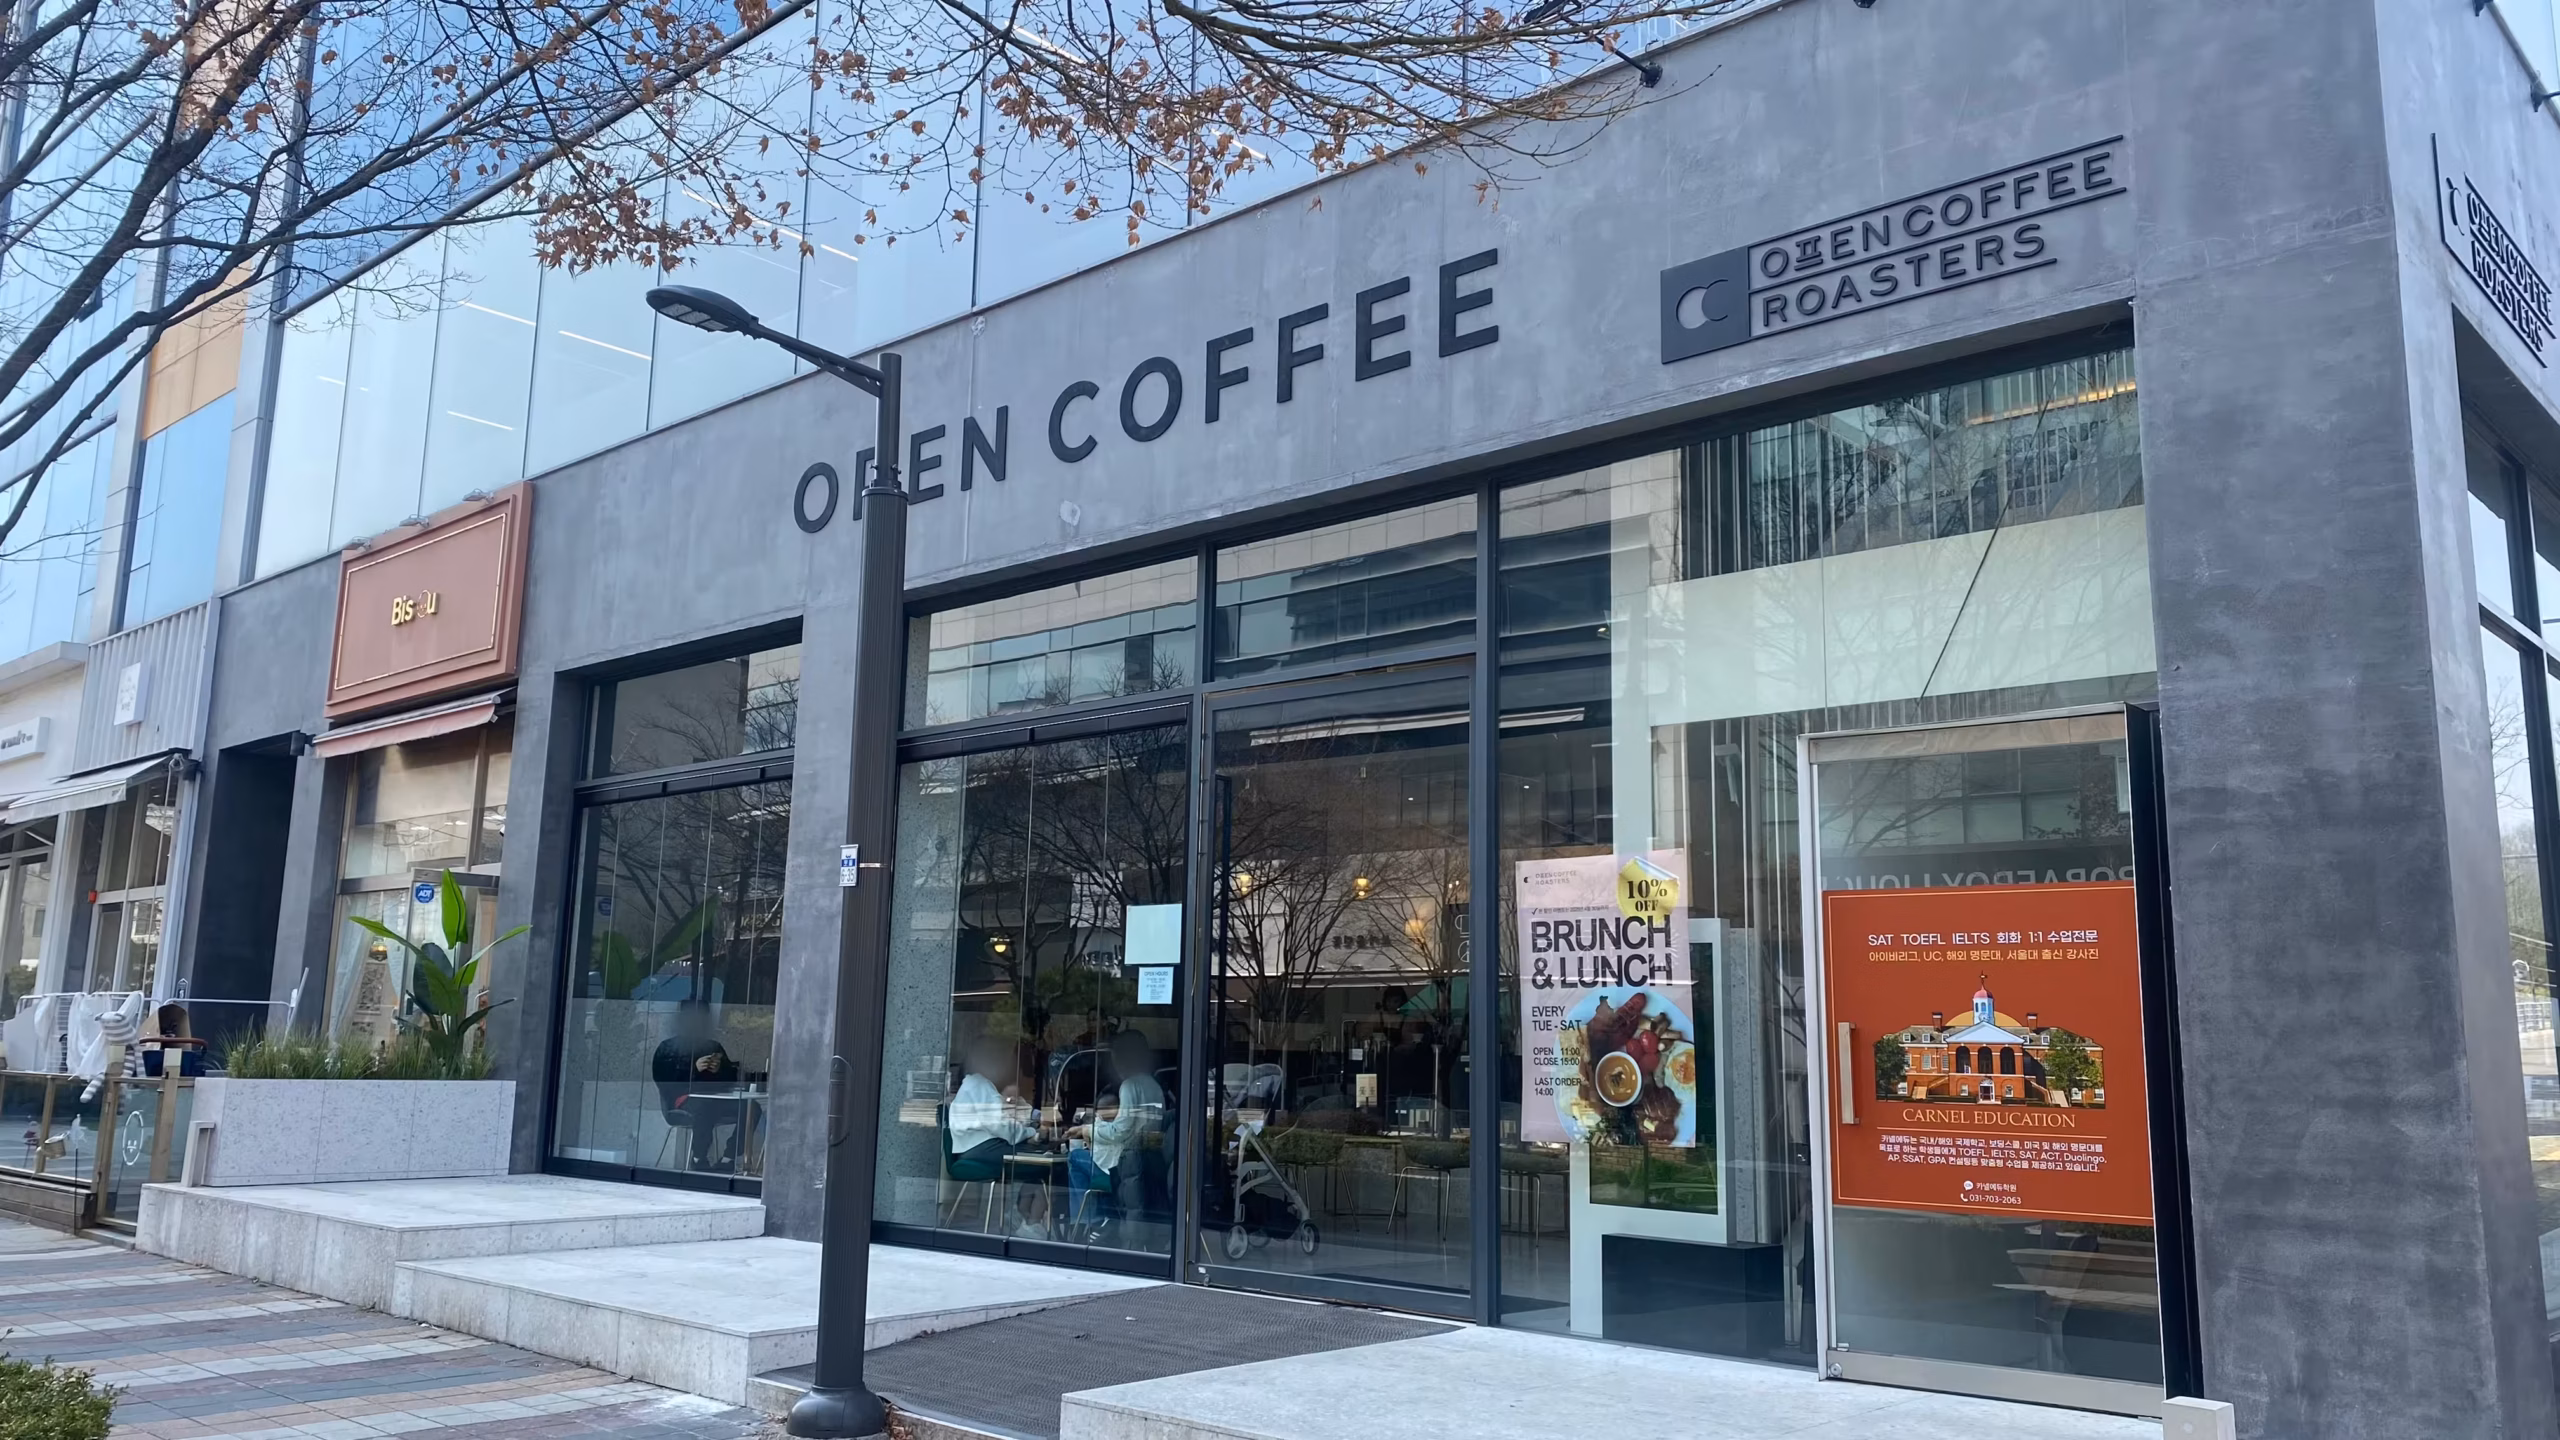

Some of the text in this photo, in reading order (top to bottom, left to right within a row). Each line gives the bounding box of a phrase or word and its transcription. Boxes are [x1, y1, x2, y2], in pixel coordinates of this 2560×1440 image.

[1903, 151, 2113, 237] COFFEE
[1762, 222, 2045, 327] ROASTERS
[2471, 240, 2544, 352] ROASTERS
[1047, 247, 1499, 464] COFFEE
[418, 889, 433, 897] ADT
[1627, 878, 1667, 899] 10%
[1635, 899, 1659, 912] OFF
[1531, 914, 1672, 953] BRUNCH
[1868, 929, 2099, 946] SAT TOEFL IELTS 회화 1:1 수업전문
[1869, 948, 2099, 962] 아이비리그, UC, 해외 명문대, 서울대 출신 강사진
[1531, 953, 1673, 990] & LUNCH
[1532, 1006, 1566, 1017] EVERY
[1532, 1020, 1552, 1031] TUE
[1560, 1020, 1582, 1031] SAT
[1533, 1047, 1580, 1056] OPEN 11:00
[1533, 1057, 1580, 1066] CLOSE 15:00
[1534, 1077, 1582, 1087] LAST ORDER
[1535, 1088, 1554, 1096] 14:00
[1902, 1108, 2076, 1128] CARNEL EDUCATION
[2024, 1141, 2040, 1150] 미국
[2052, 1142, 2068, 1151] 해외
[1903, 1145, 1917, 1154] 하는
[1958, 1148, 1989, 1157] TOEFL,
[1991, 1150, 2018, 1159] IELTS,
[2019, 1151, 2039, 1160] SAT,
[2040, 1152, 2062, 1161] ACT,
[2063, 1153, 2107, 1165] Duolingo,
[1902, 1155, 1927, 1164] SSAT,
[1928, 1156, 1947, 1165] GPA
[2006, 1159, 2029, 1169] 수업을
[2031, 1160, 2063, 1171] 제공하고
[2065, 1162, 2101, 1173] 있습니다.
[1969, 1194, 2022, 1205] 031-703-2063
